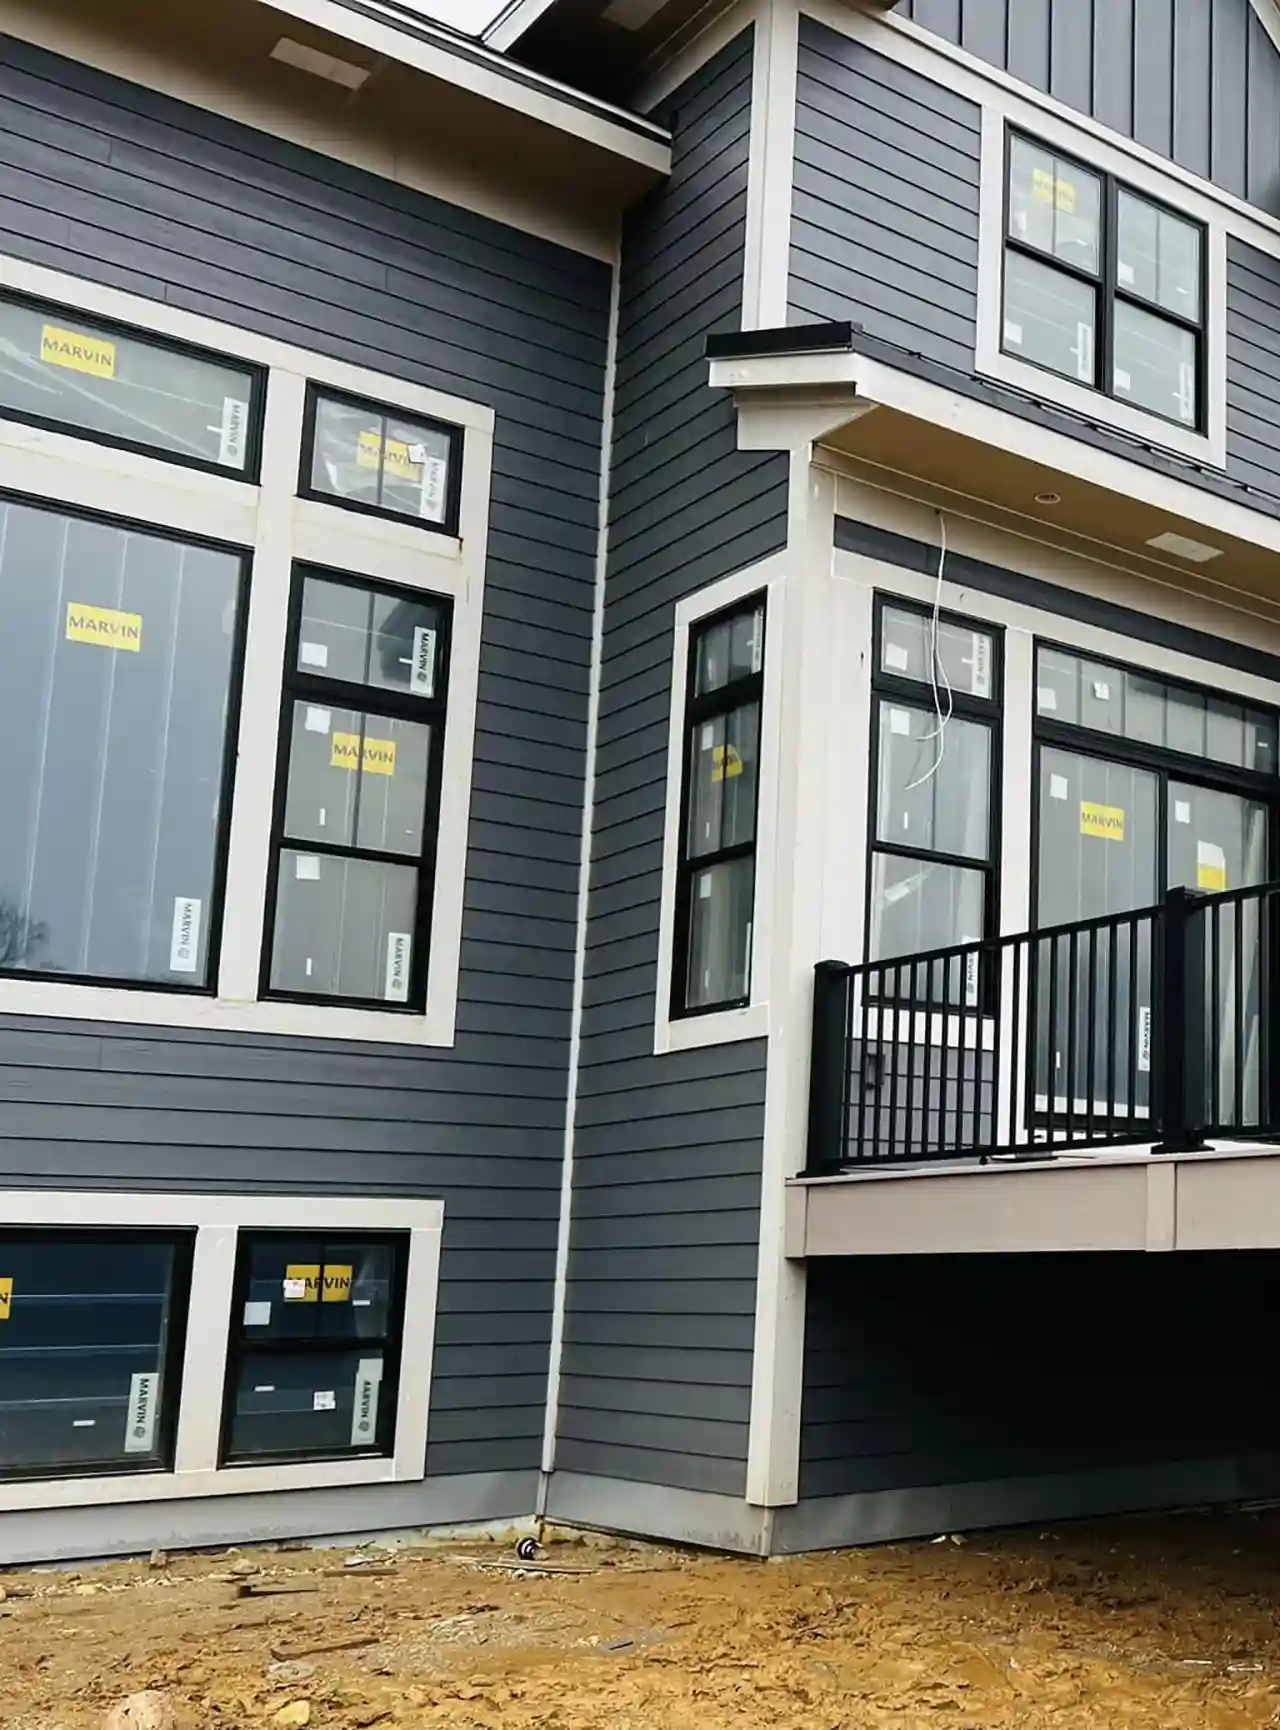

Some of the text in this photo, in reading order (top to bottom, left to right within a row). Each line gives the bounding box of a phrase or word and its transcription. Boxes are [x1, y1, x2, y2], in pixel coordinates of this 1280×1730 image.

[42, 336, 112, 367] MARVIN
[69, 615, 138, 640] MARVIN
[419, 632, 430, 670] MARVIN
[1080, 811, 1124, 830] MARVIN
[180, 903, 191, 947] MARVIN
[394, 937, 404, 977] MARVIN
[136, 1378, 150, 1423] MARVIN
